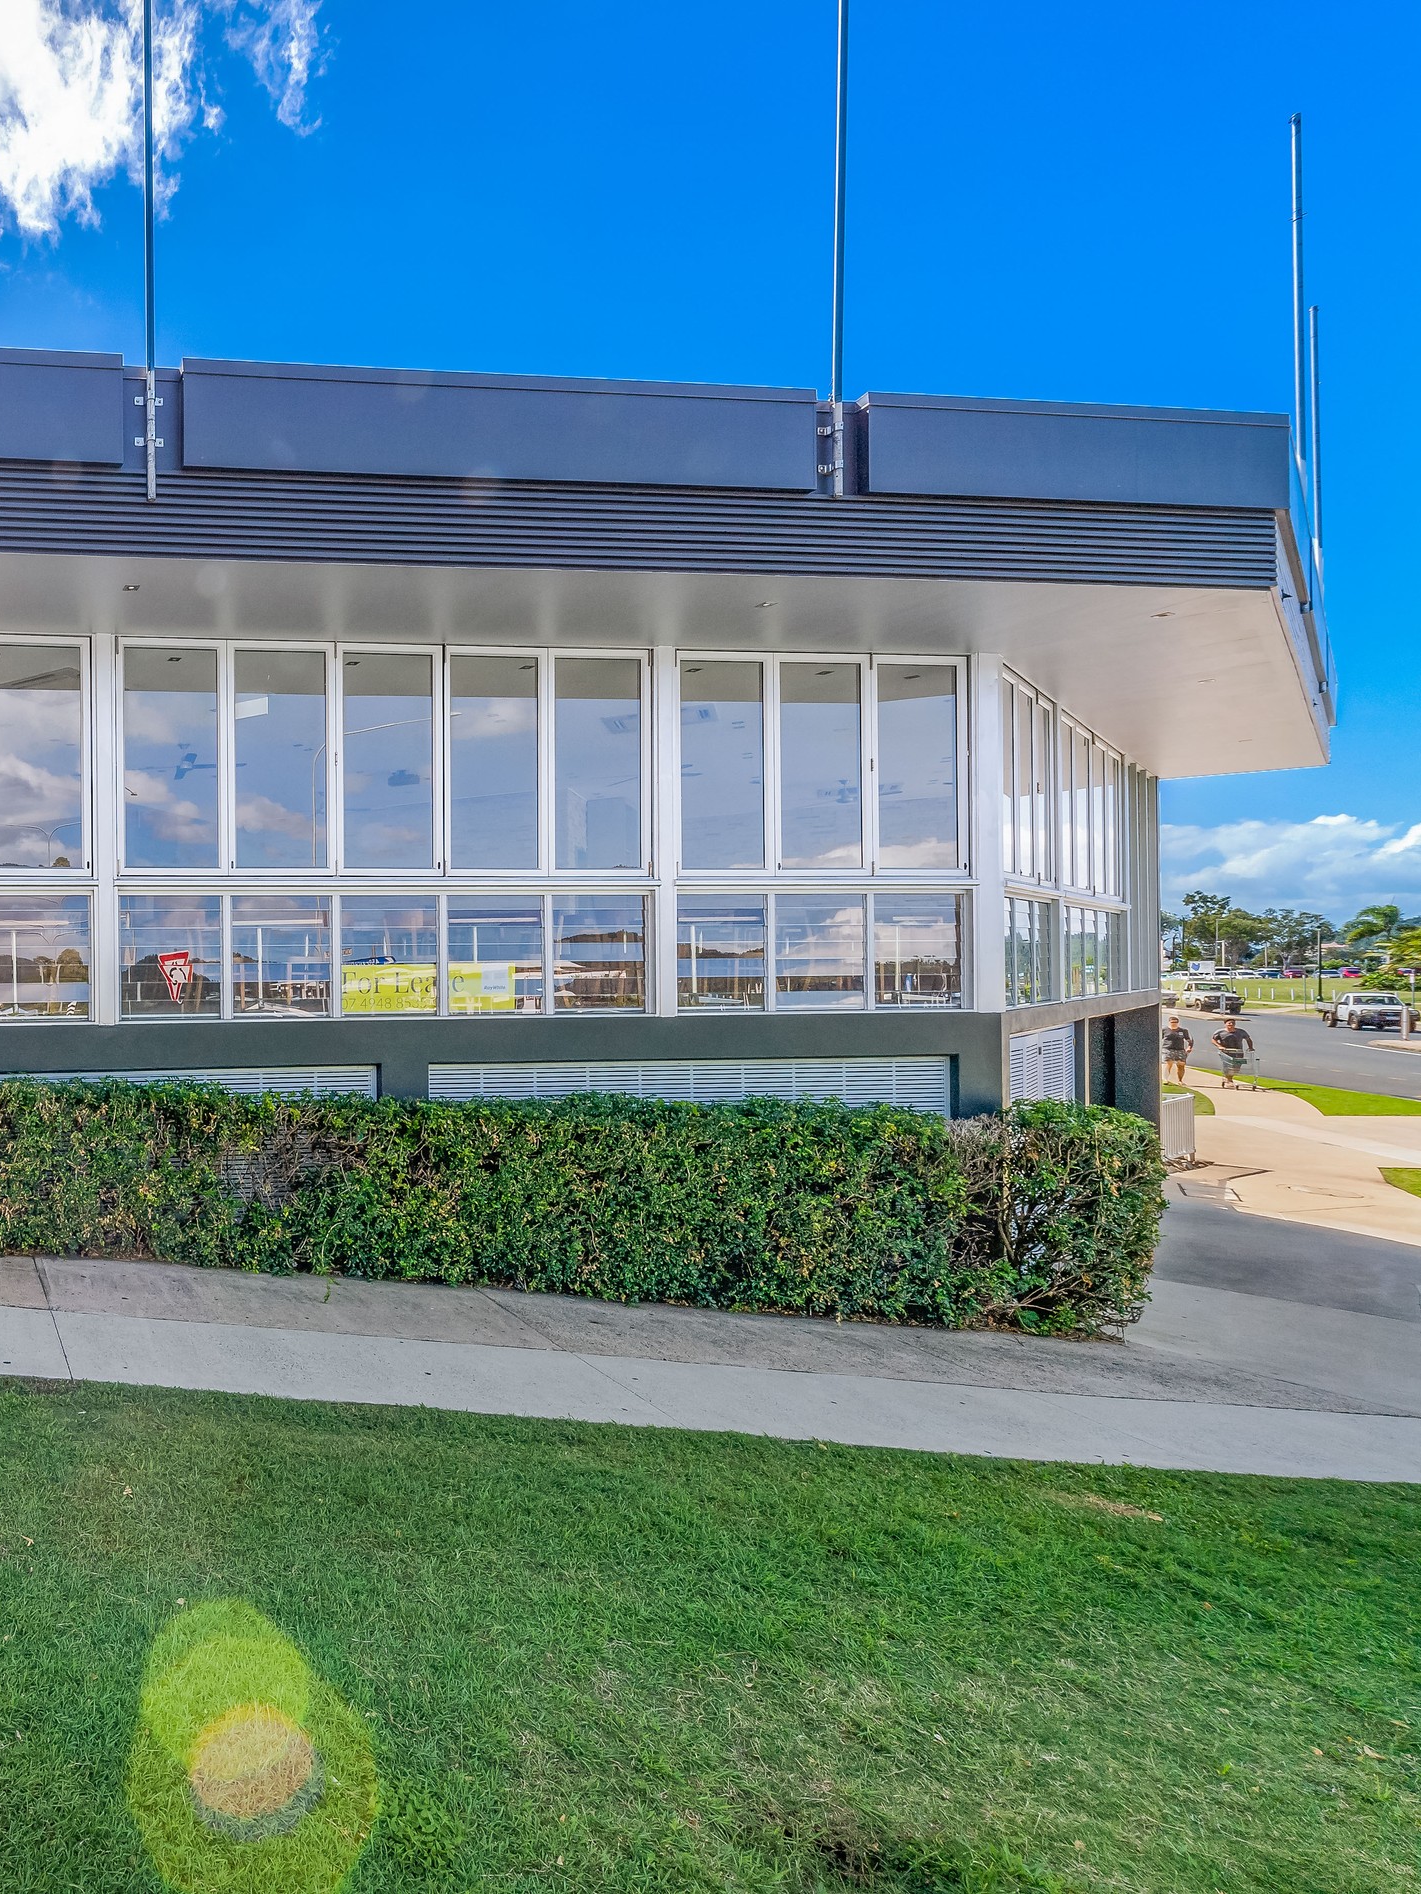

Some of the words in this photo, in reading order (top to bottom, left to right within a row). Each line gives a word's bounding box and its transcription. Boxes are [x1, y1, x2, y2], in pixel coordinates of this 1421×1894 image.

[342, 972, 386, 994] For
[395, 971, 465, 994] Leae
[342, 998, 356, 1010] 07
[360, 998, 392, 1010] 4948
